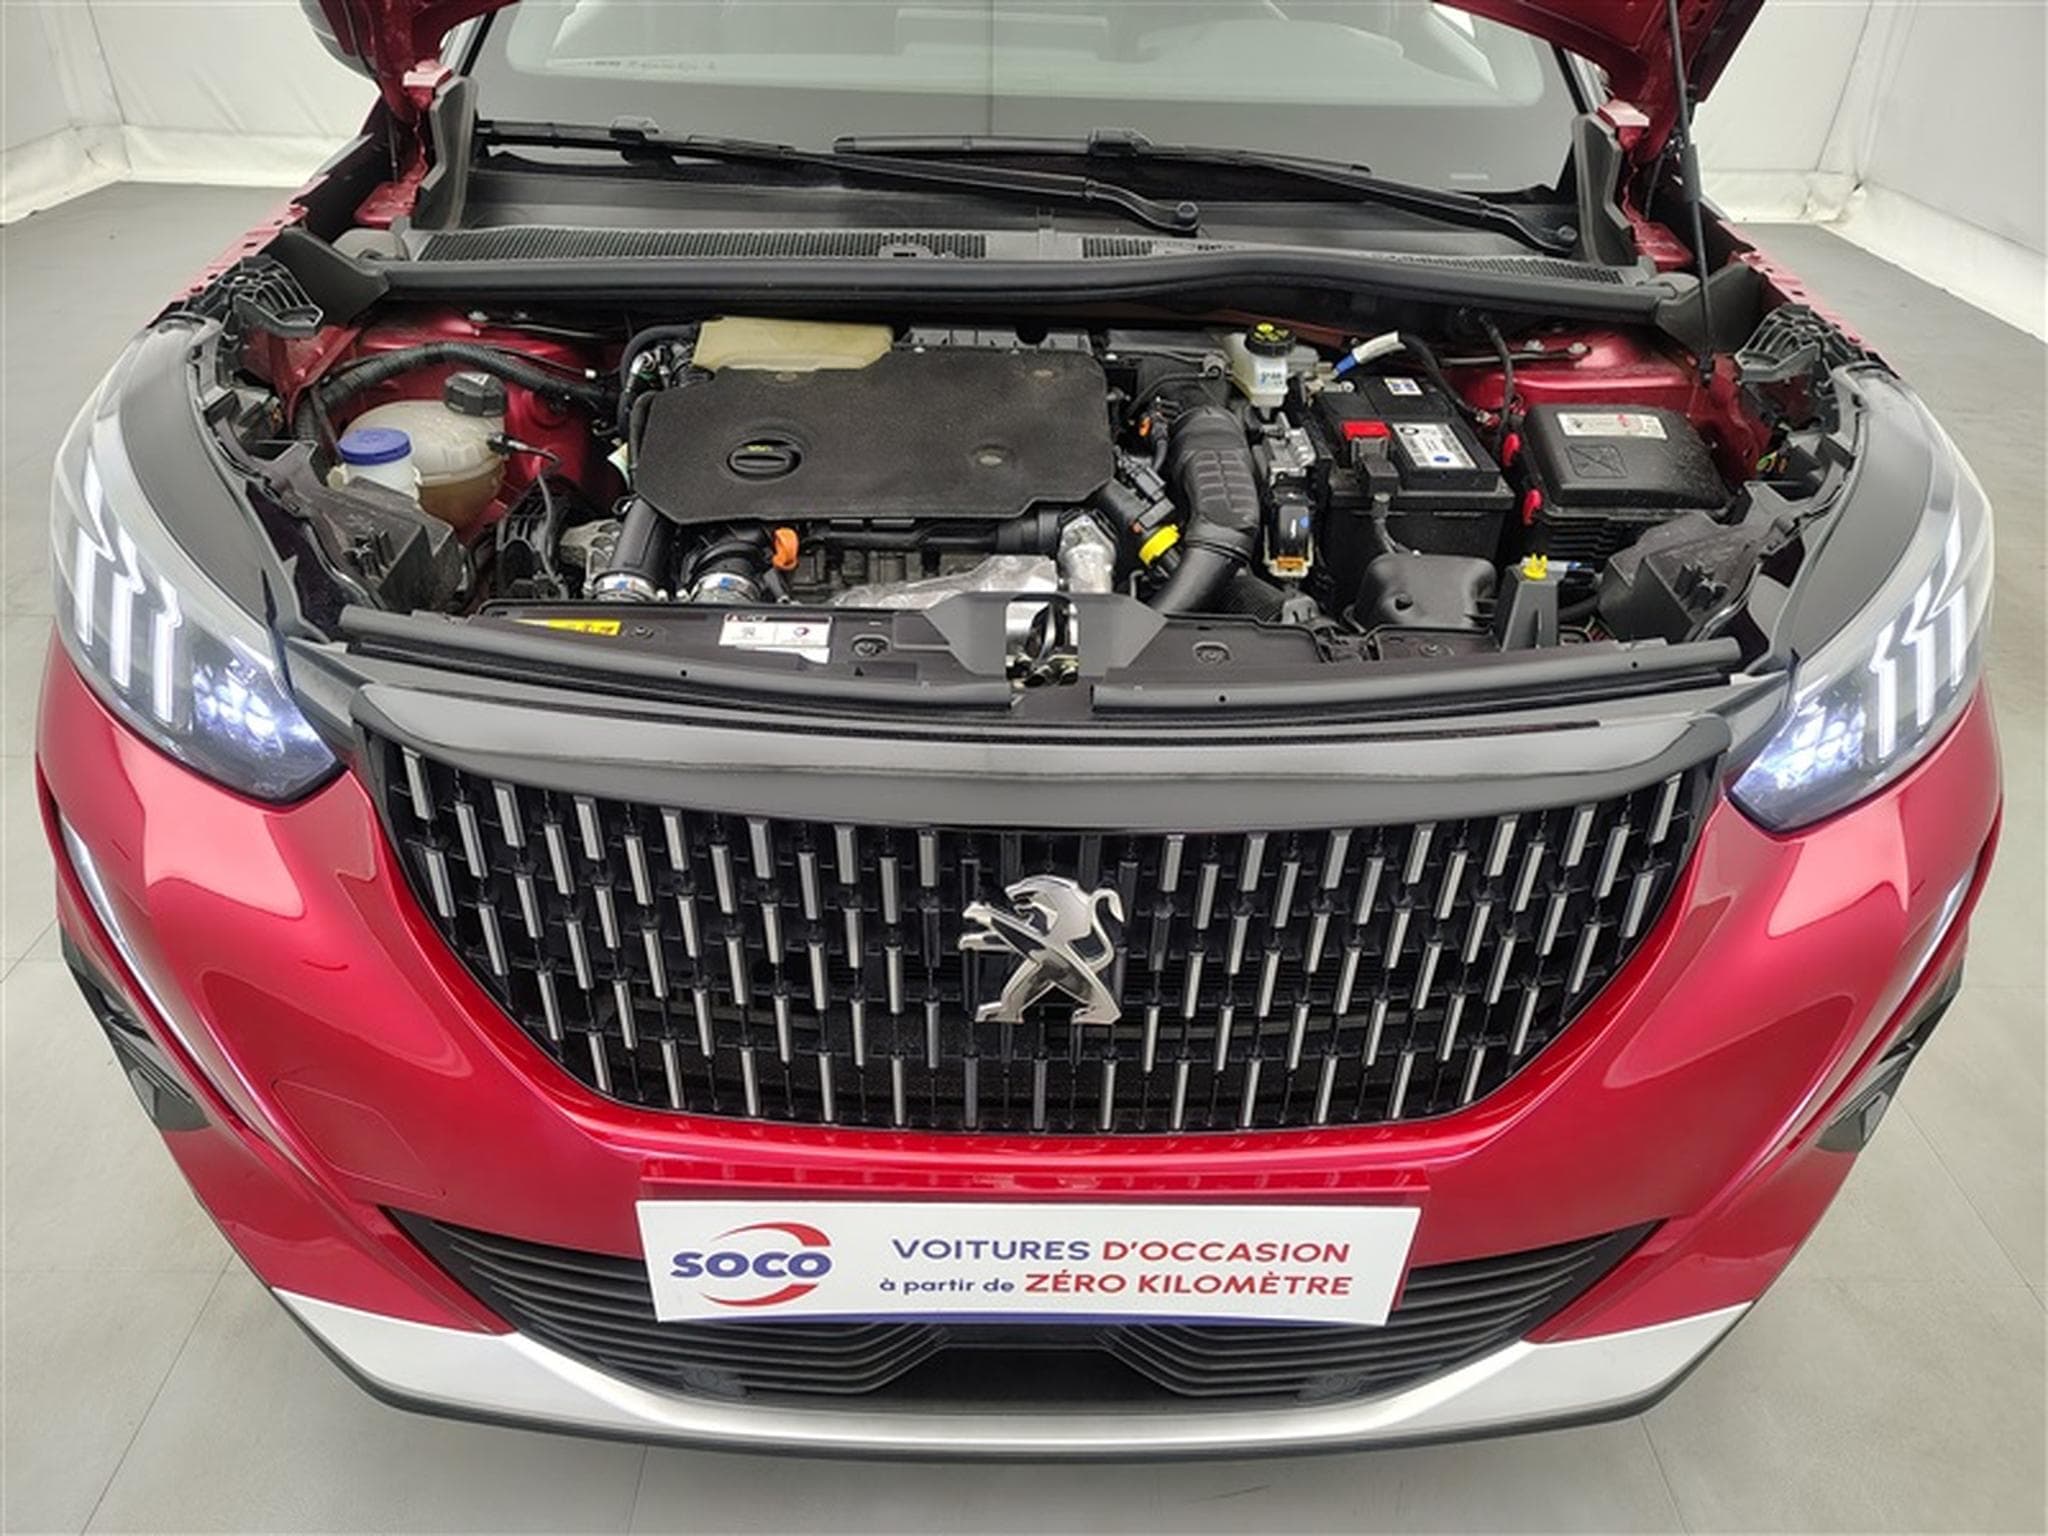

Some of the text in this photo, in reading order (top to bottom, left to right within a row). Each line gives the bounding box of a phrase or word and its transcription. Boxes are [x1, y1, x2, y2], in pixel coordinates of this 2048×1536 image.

[892, 1239, 1350, 1262] VOITURES D'OCCASION
[670, 1252, 832, 1278] SOCO
[879, 1269, 1352, 1295] à partir de ZÉRO KILOMÈTRE
